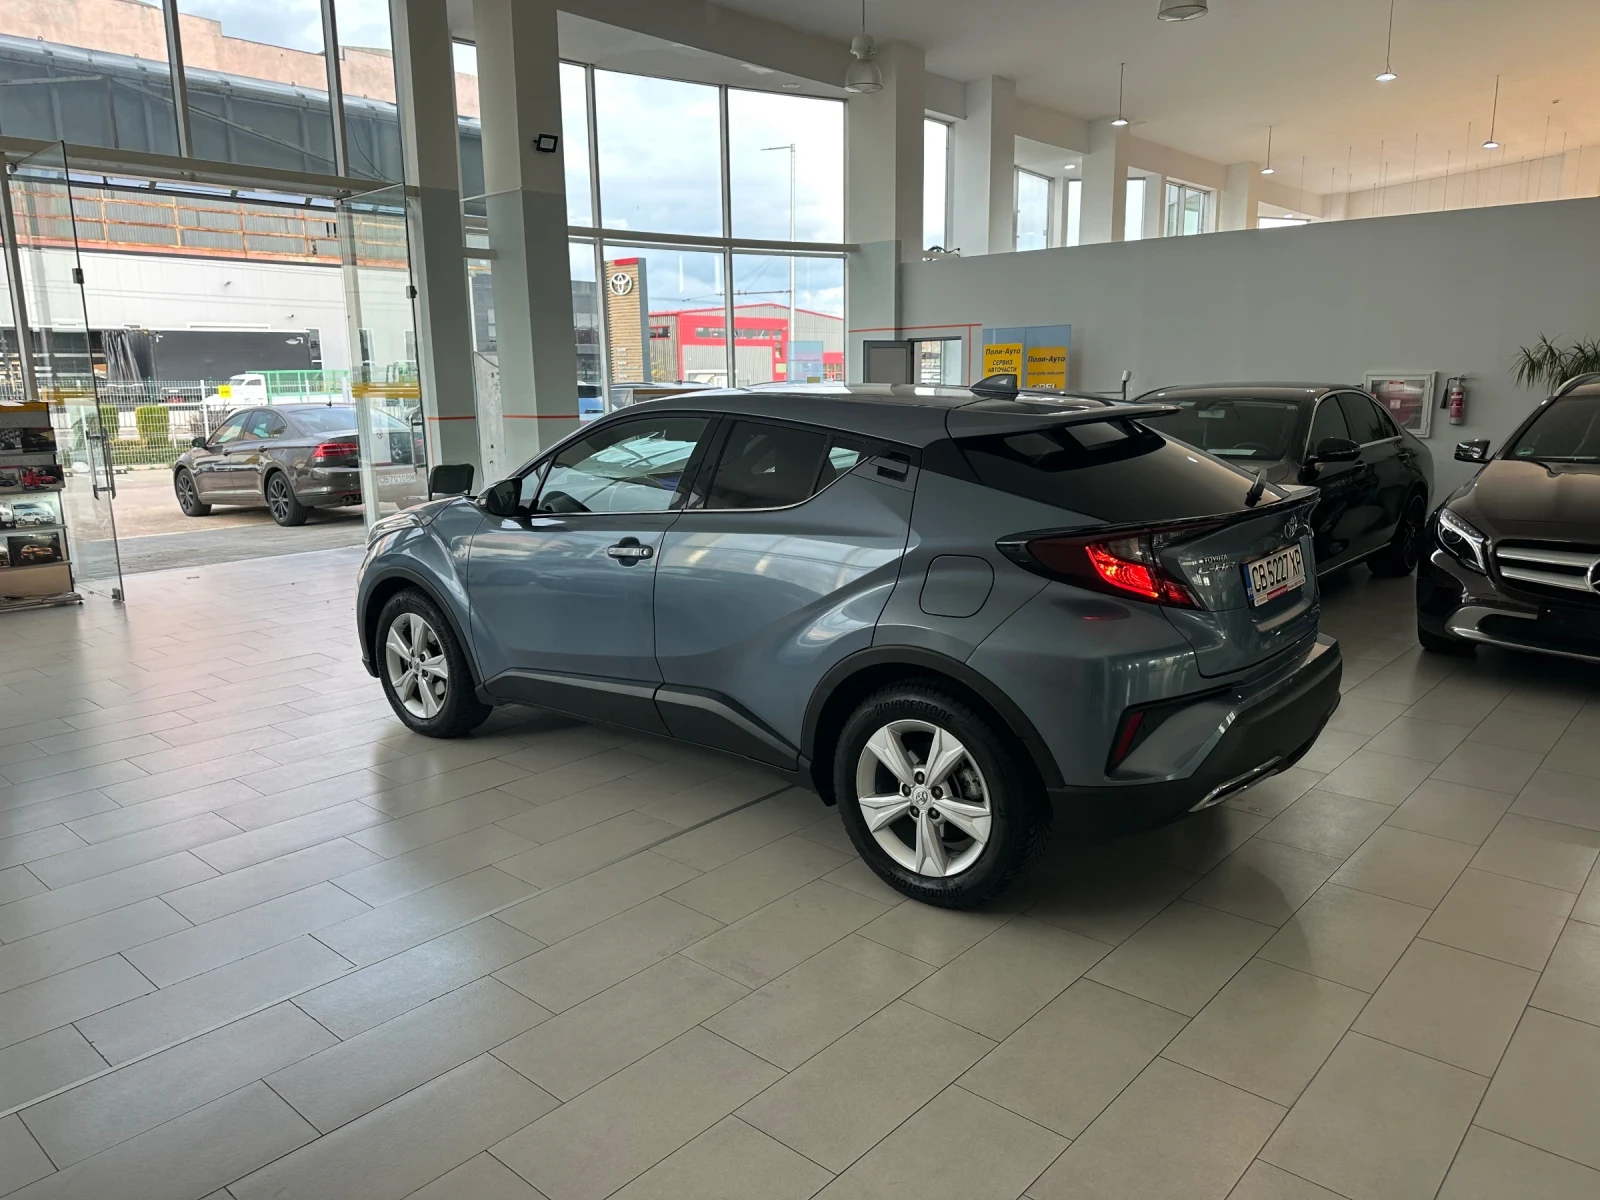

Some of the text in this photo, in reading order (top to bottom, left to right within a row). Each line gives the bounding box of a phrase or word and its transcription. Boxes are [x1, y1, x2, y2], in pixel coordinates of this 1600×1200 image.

[1028, 355, 1066, 363] Поли-Ауто
[1203, 554, 1228, 563] TOYOTA
[1251, 548, 1301, 592] CB 5227 XP
[875, 699, 955, 723] BRIDGESTONE
